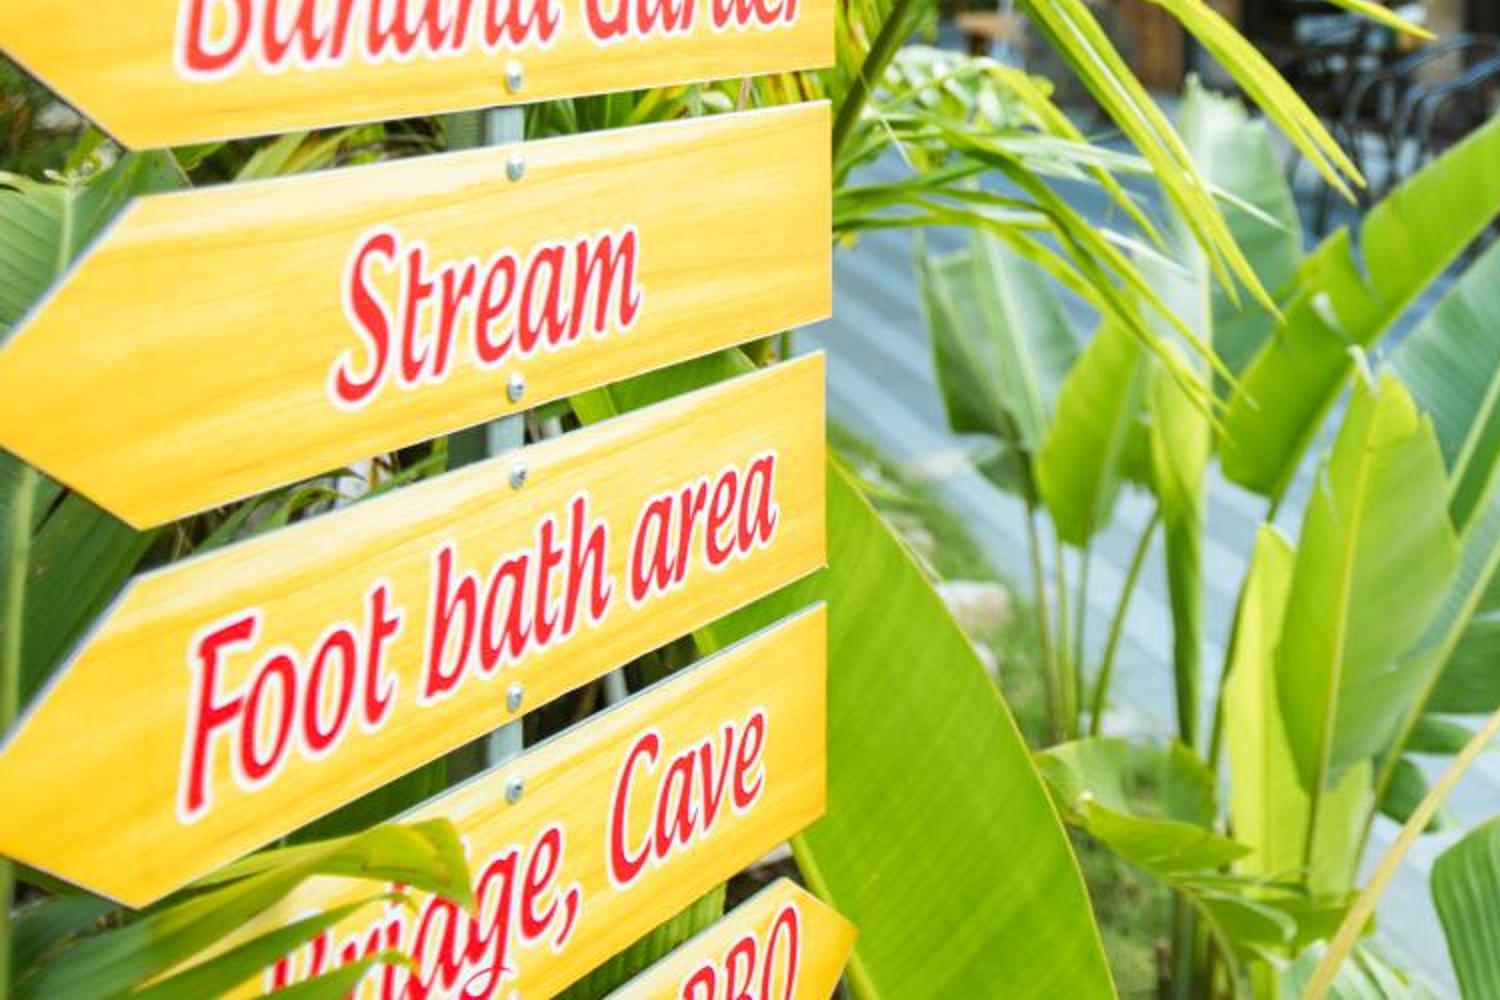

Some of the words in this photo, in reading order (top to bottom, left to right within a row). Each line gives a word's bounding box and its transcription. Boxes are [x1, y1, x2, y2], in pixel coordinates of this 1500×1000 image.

[334, 231, 641, 402] Stream
[186, 587, 399, 811] Foot
[425, 495, 609, 697] bath
[632, 451, 778, 602] area
[610, 710, 765, 884] Cave
